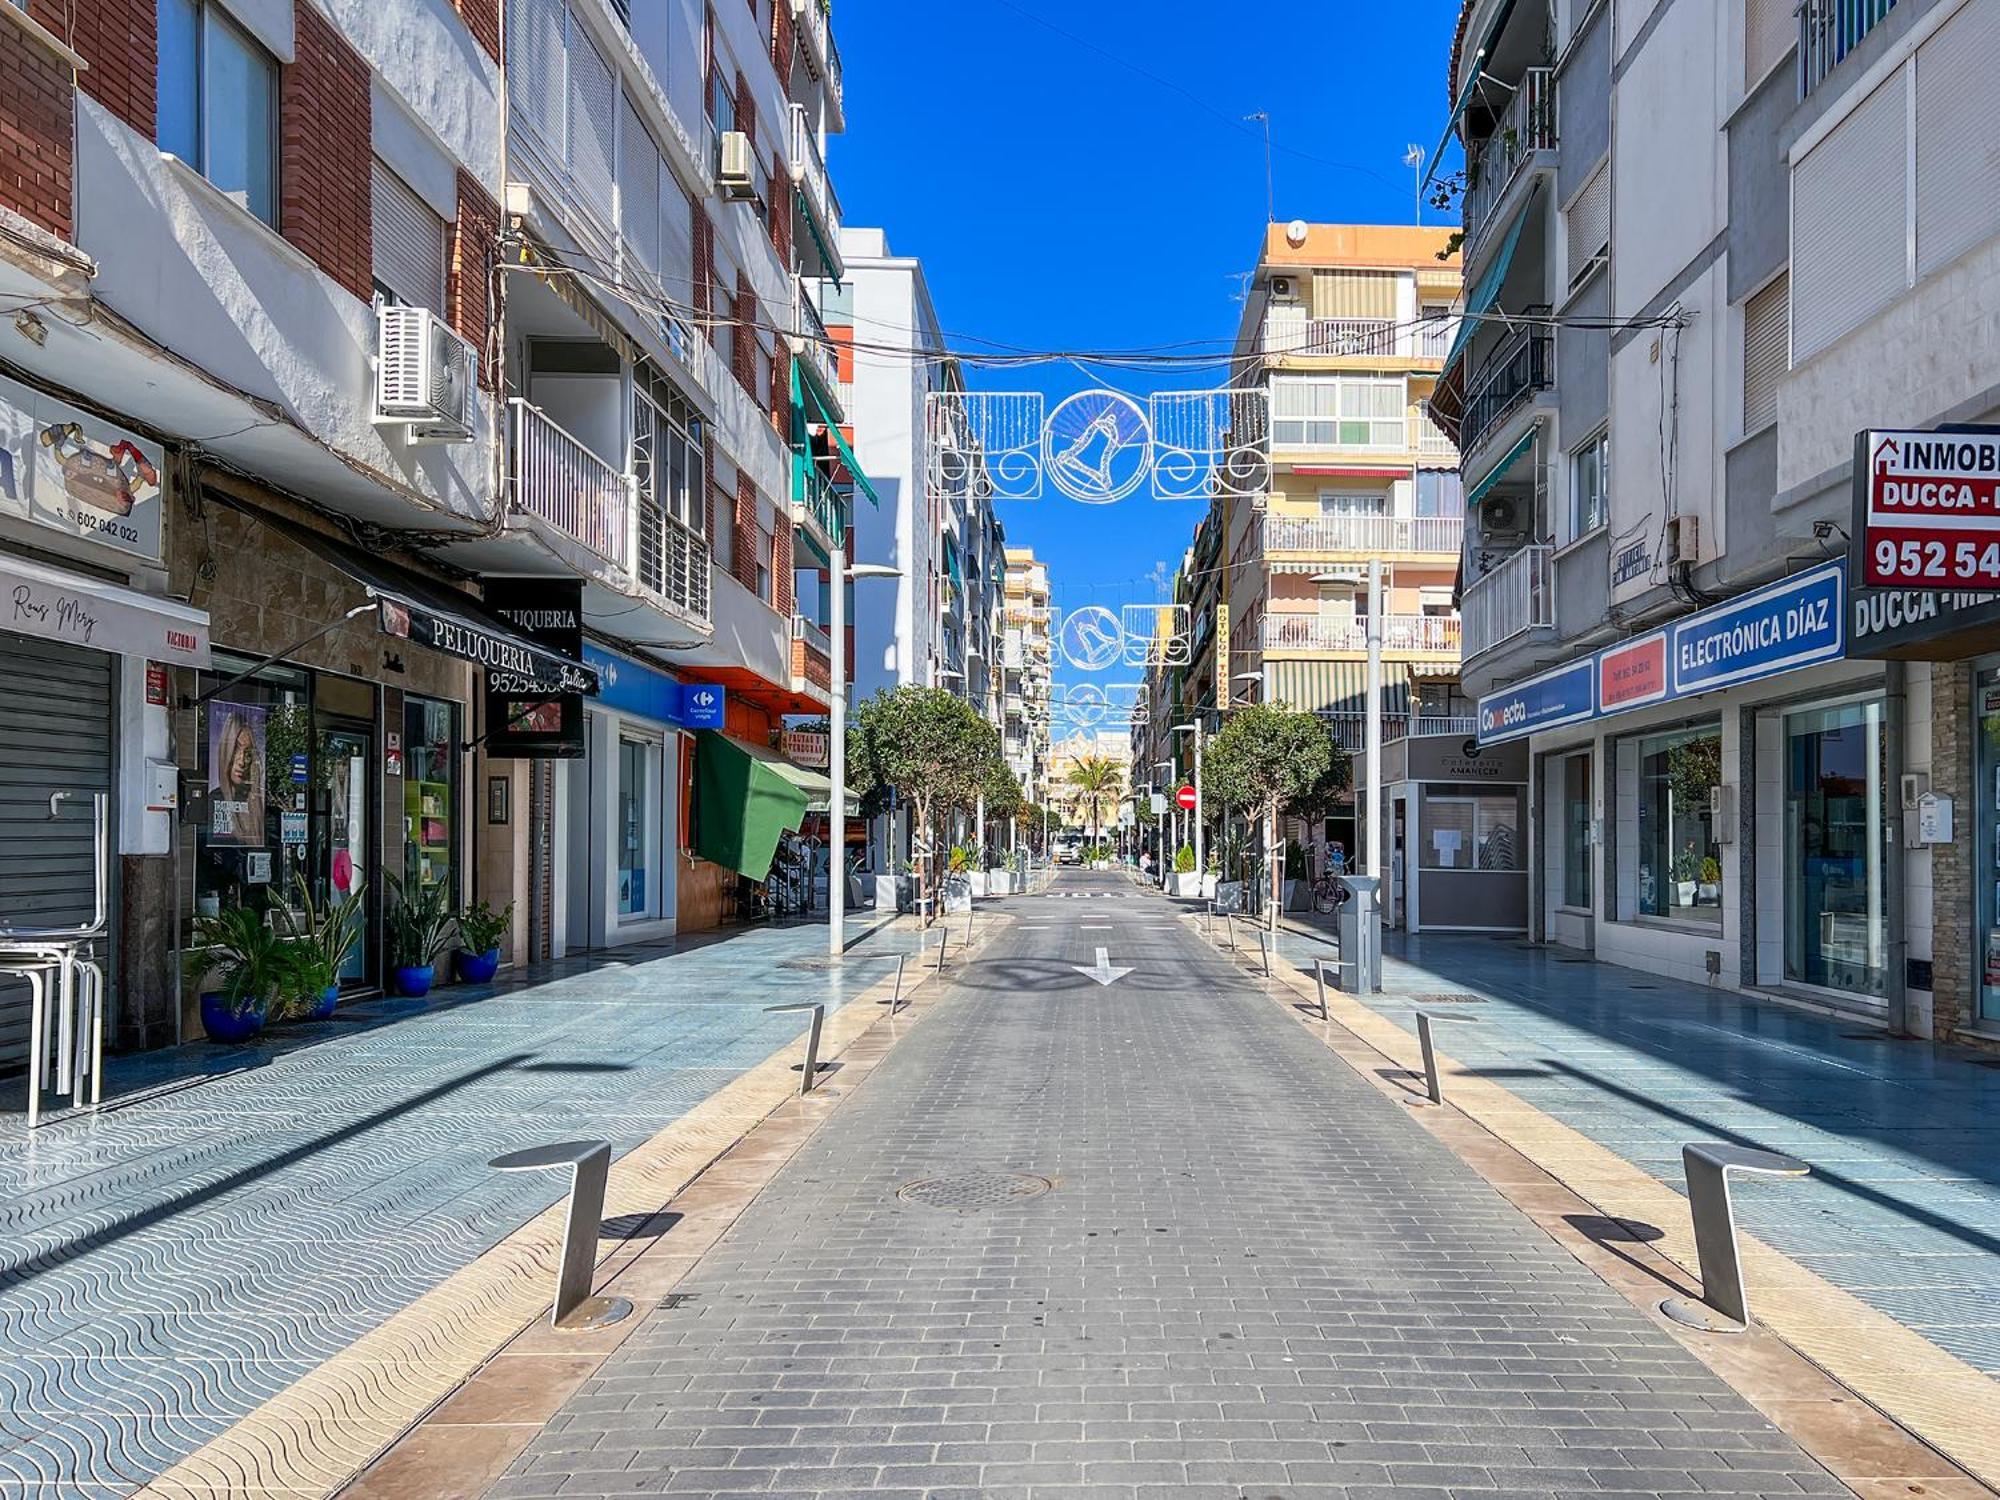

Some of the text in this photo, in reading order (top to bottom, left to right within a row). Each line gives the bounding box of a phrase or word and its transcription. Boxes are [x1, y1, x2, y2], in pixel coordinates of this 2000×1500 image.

[1904, 442, 2000, 472] INMOB
[1883, 482, 1975, 508] DUCCA
[77, 511, 138, 543] 602 042 022
[1875, 539, 2000, 578] 952 54
[56, 596, 99, 643] Mery
[1855, 591, 1937, 638] DUCCA
[167, 630, 197, 650] VICTORIA
[432, 619, 535, 676] PELUQUERIA
[1682, 615, 1781, 671] ELECTRÓNICA
[1786, 598, 1829, 640] DÍAZ
[560, 664, 587, 689] Julia
